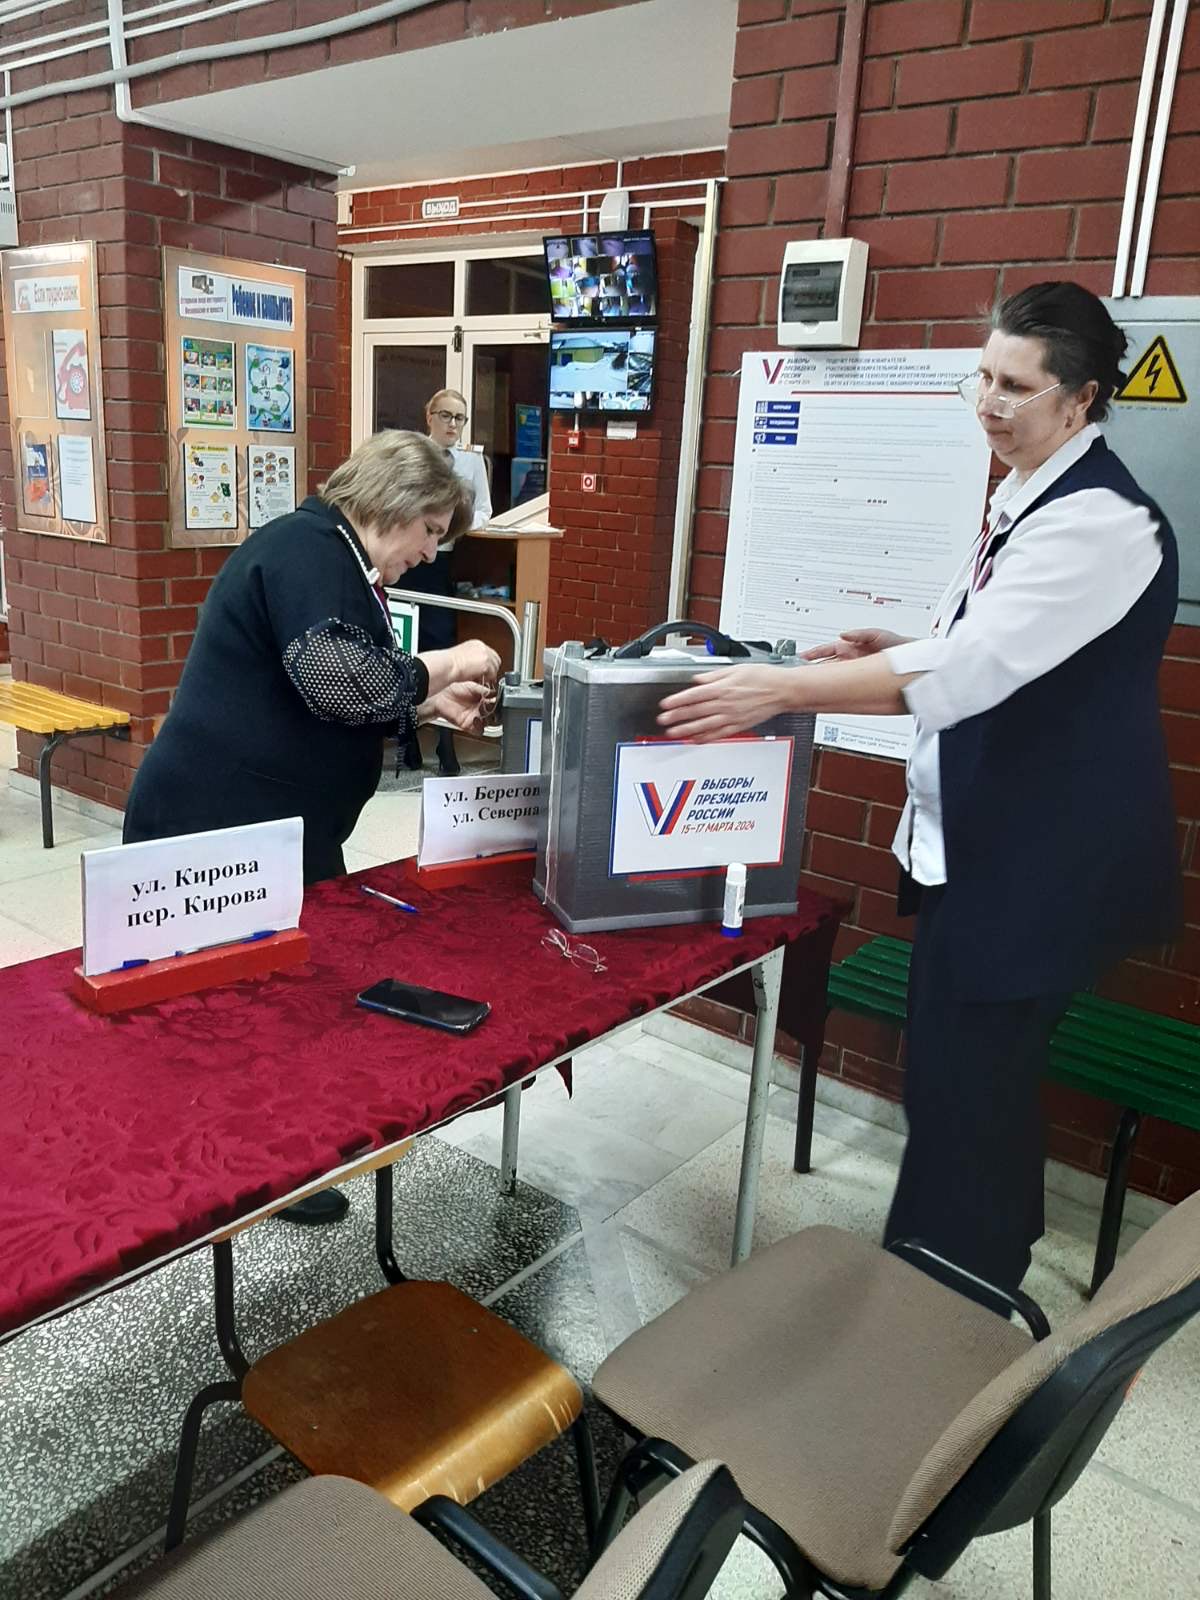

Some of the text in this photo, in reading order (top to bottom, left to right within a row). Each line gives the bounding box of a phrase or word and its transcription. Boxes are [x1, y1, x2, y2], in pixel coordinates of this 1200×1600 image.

[426, 200, 456, 214] ВЫХОД
[701, 777, 754, 790] ВЫБОРЫ
[444, 791, 468, 807] ул.
[694, 791, 768, 805] ПРЕЗИДЕНТА
[452, 813, 474, 827] ул.
[687, 808, 735, 821] РОССИИ
[705, 822, 734, 832] МАРТА
[735, 820, 755, 830] 2024
[132, 859, 259, 901] ул. Кирова
[127, 887, 267, 927] пер. Кирова
